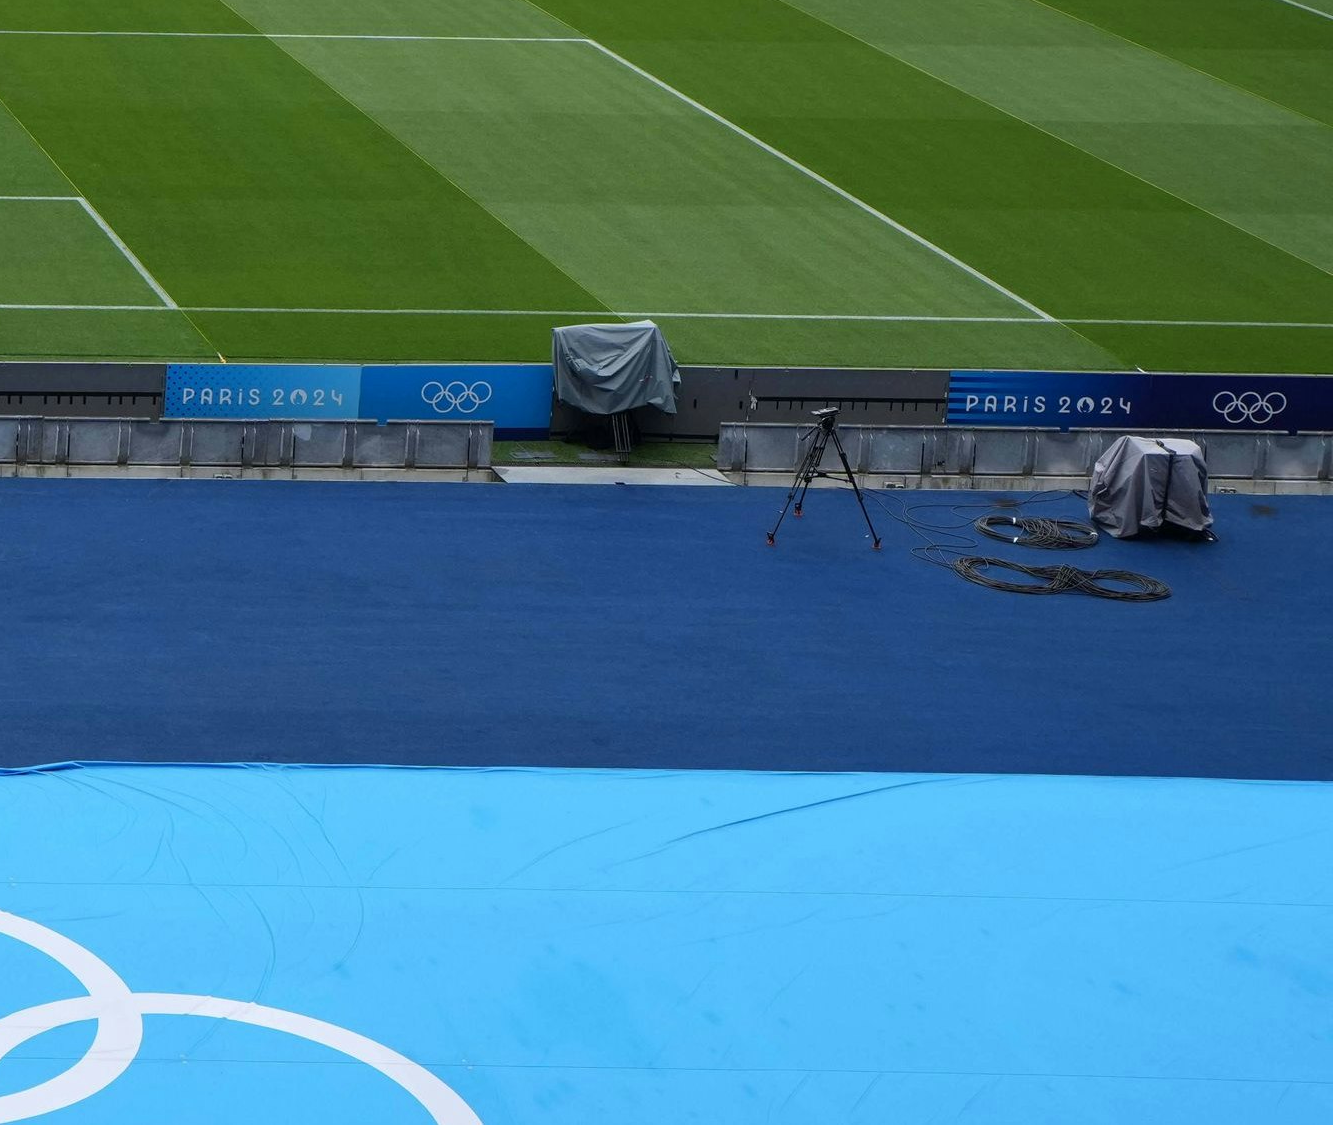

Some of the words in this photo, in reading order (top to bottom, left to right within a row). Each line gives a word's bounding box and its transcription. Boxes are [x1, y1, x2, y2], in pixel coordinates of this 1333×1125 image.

[182, 387, 261, 406] PARIS
[272, 388, 344, 407] 2024
[966, 395, 1046, 414] PARIS
[1058, 396, 1132, 415] 2024
